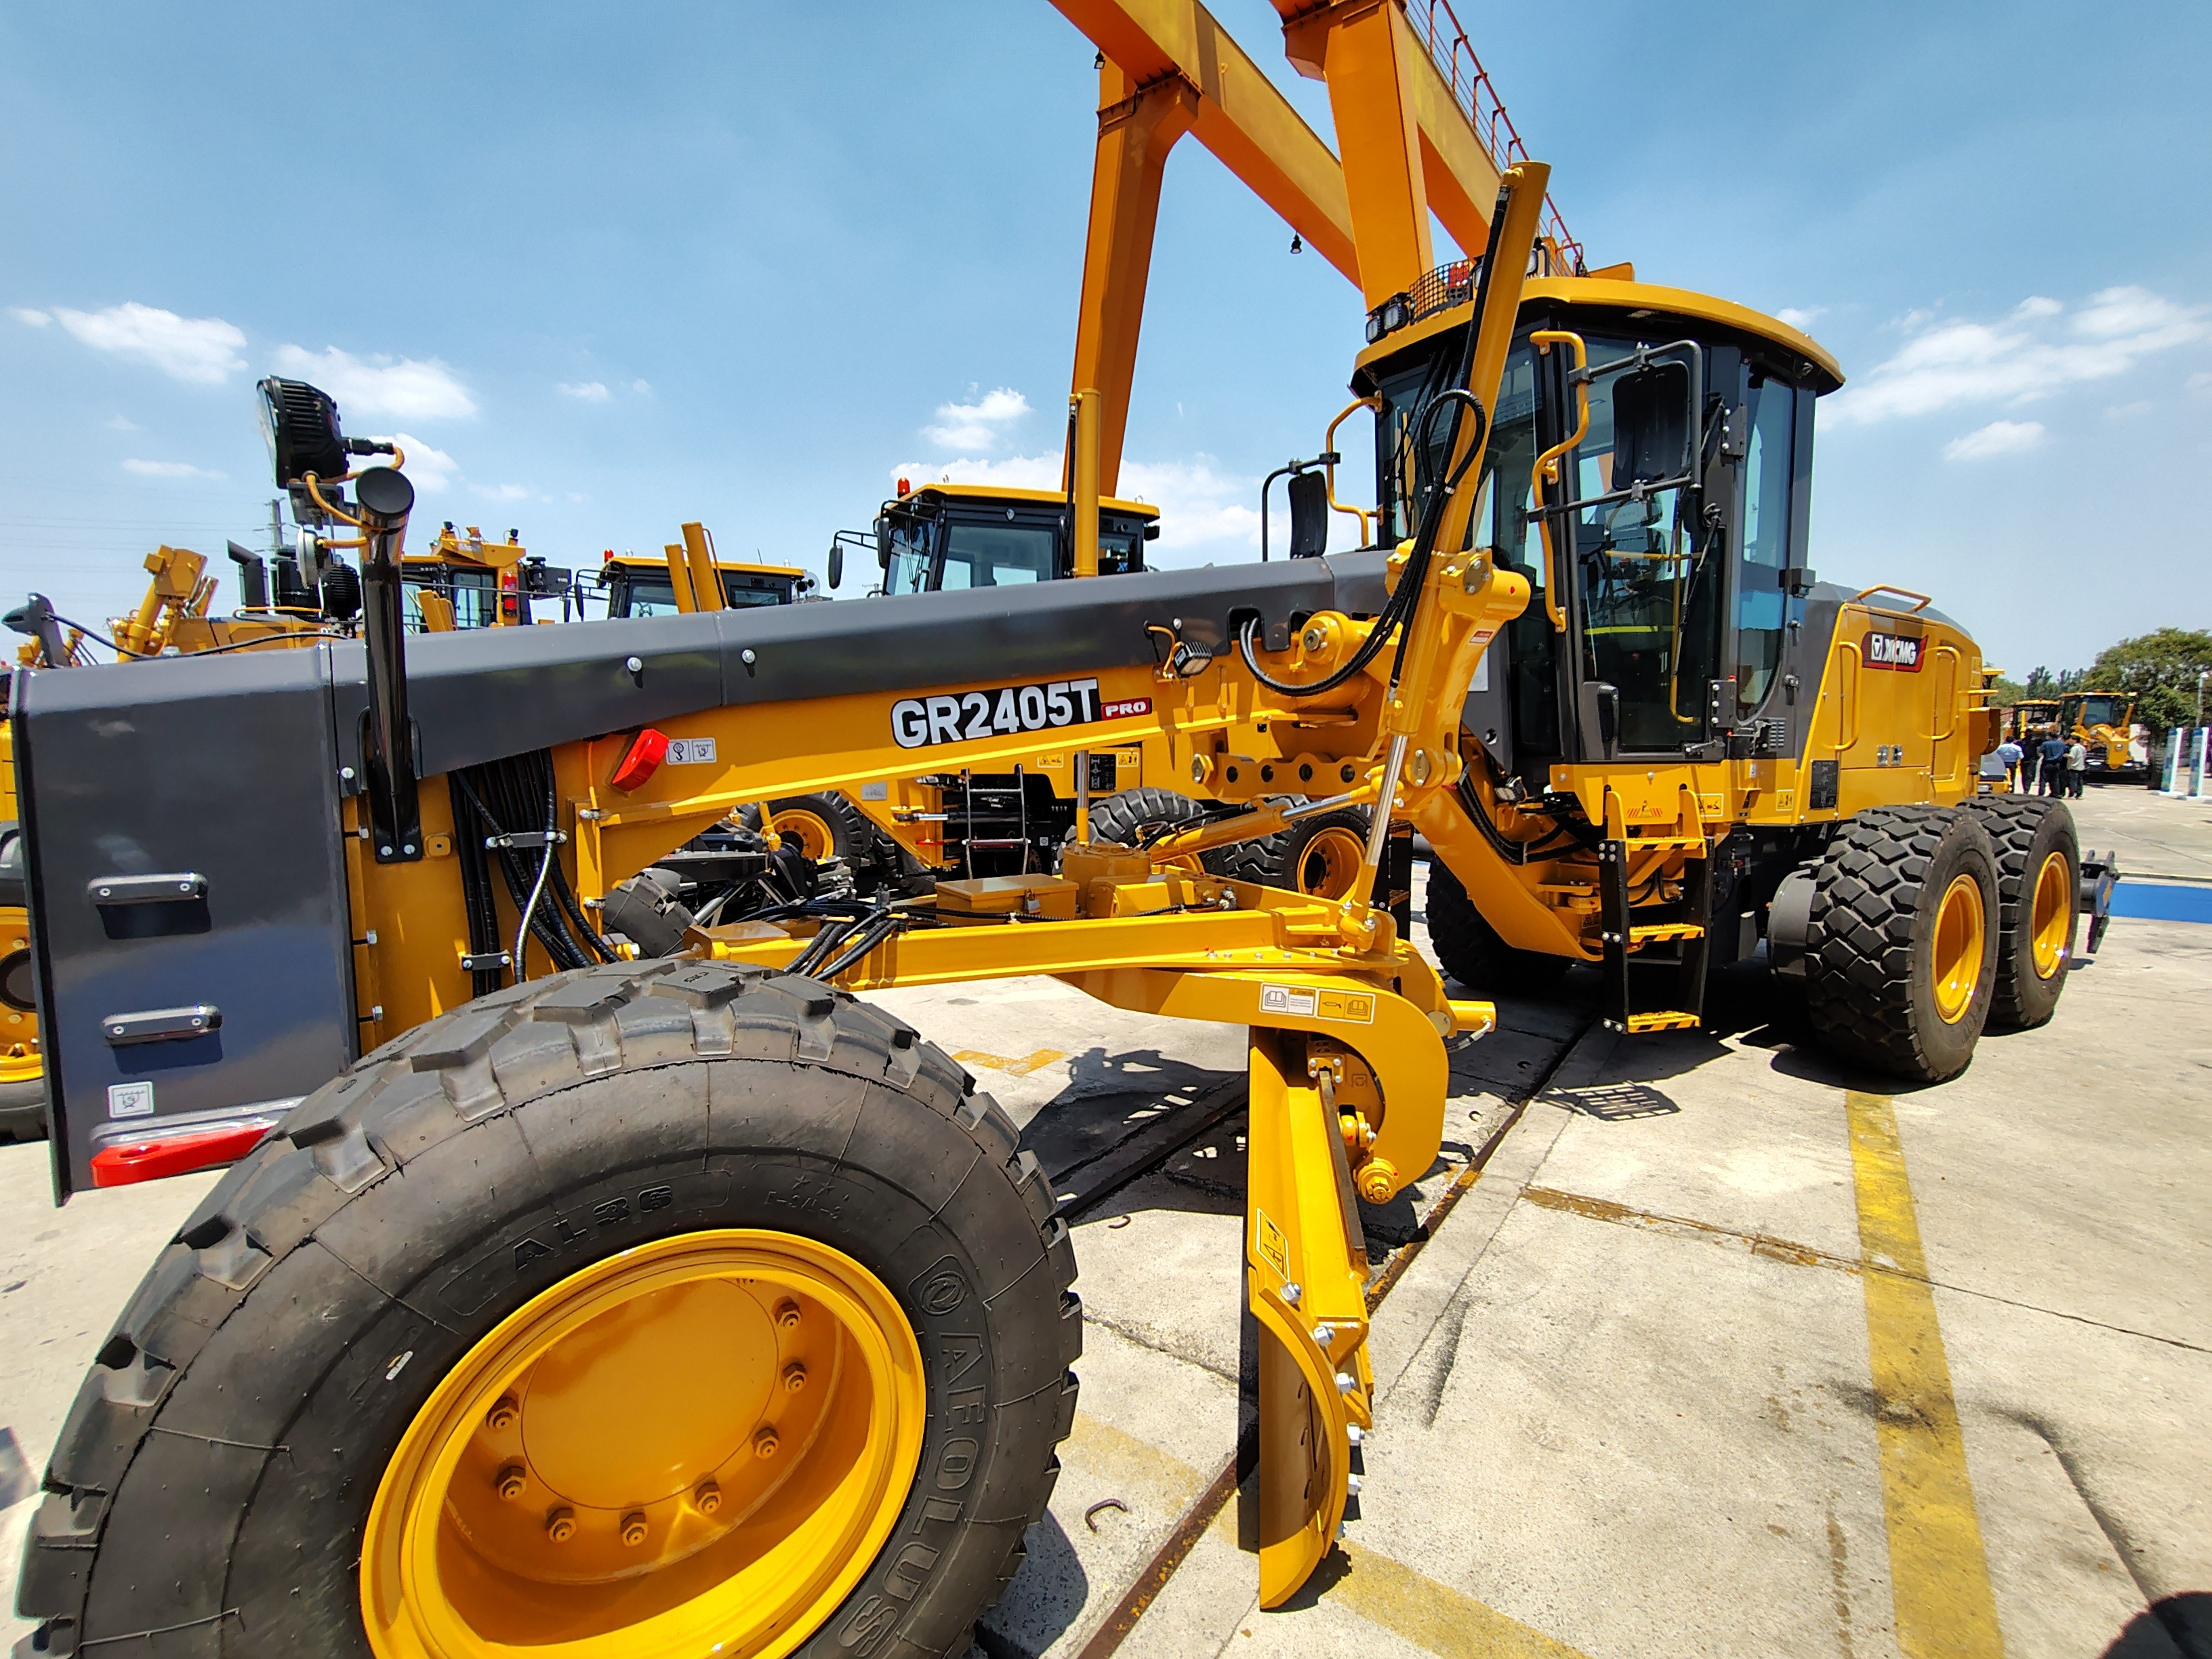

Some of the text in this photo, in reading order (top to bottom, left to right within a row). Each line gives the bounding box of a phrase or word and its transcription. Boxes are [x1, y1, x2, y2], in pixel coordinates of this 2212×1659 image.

[1882, 639, 1917, 665] XCMG
[892, 679, 1147, 747] GR2405T PRO
[837, 1332, 987, 1658] AEOLUS
